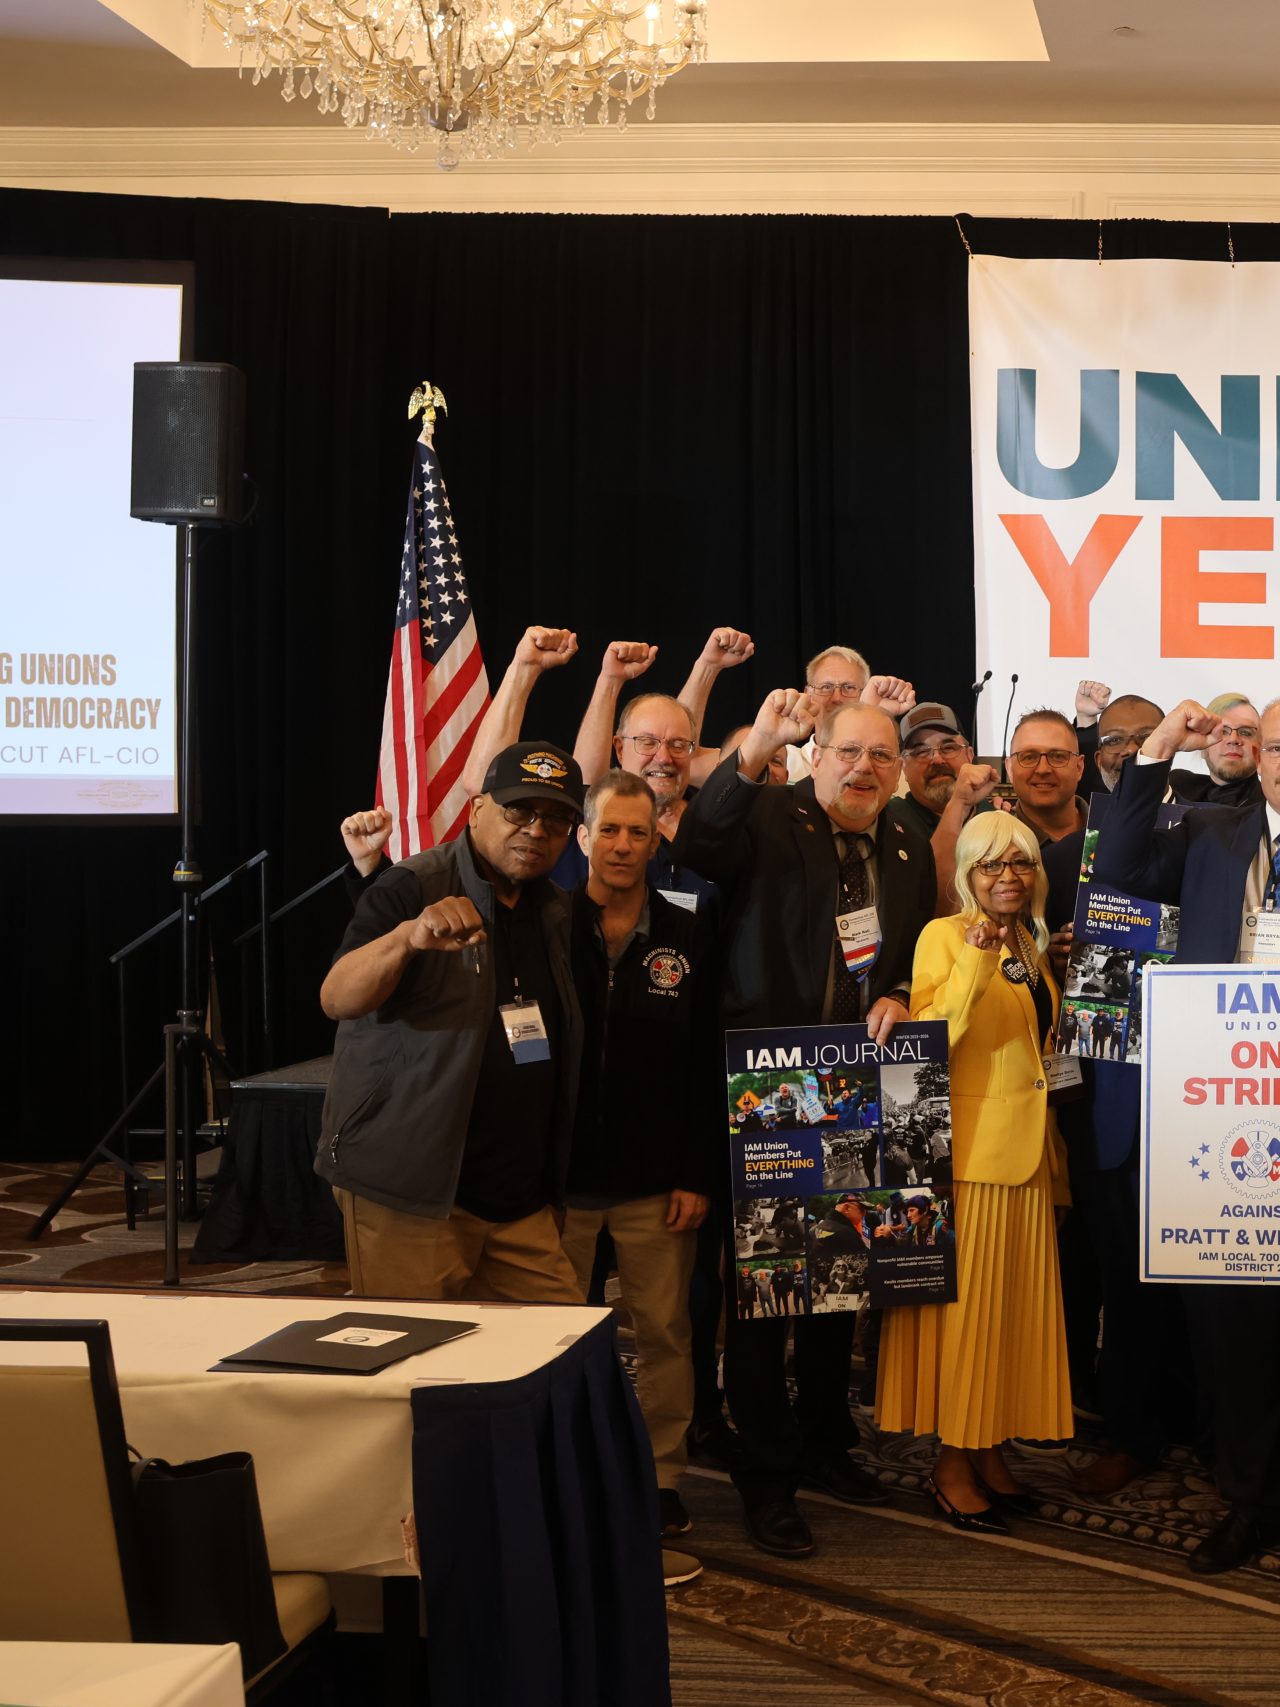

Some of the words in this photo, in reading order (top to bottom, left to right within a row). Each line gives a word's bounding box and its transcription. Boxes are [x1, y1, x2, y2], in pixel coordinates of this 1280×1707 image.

[20, 653, 117, 686] UNIONS
[5, 696, 162, 730] DEMOCRACY
[0, 745, 48, 763] CUT
[58, 746, 160, 765] AFL-CIO
[1090, 892, 1106, 902] IAM
[1108, 895, 1130, 905] Union
[1088, 901, 1126, 913] Members
[1127, 906, 1141, 915] Put
[1087, 909, 1152, 926] EVERYTHING
[1086, 919, 1097, 927] On
[1099, 920, 1112, 929] the
[1113, 923, 1130, 932] Line
[642, 947, 676, 967] MACHINISTS
[648, 987, 666, 995] Local
[746, 1046, 802, 1070] IAM
[805, 1040, 930, 1067] JOURNAL
[744, 1143, 762, 1152] IAM
[764, 1142, 789, 1150] Union
[745, 1152, 785, 1161] Members
[787, 1150, 802, 1158] Put
[745, 1158, 815, 1172] EVERYTHING
[745, 1173, 758, 1181] On
[760, 1172, 773, 1180] the
[775, 1171, 794, 1179] Line
[1160, 1227, 1230, 1245] PRATT
[1235, 1229, 1250, 1245] &
[1198, 1252, 1218, 1261] IAM
[1221, 1252, 1257, 1262] LOCAL
[1259, 1252, 1280, 1262] 700
[1224, 1262, 1275, 1272] DISTRICT
